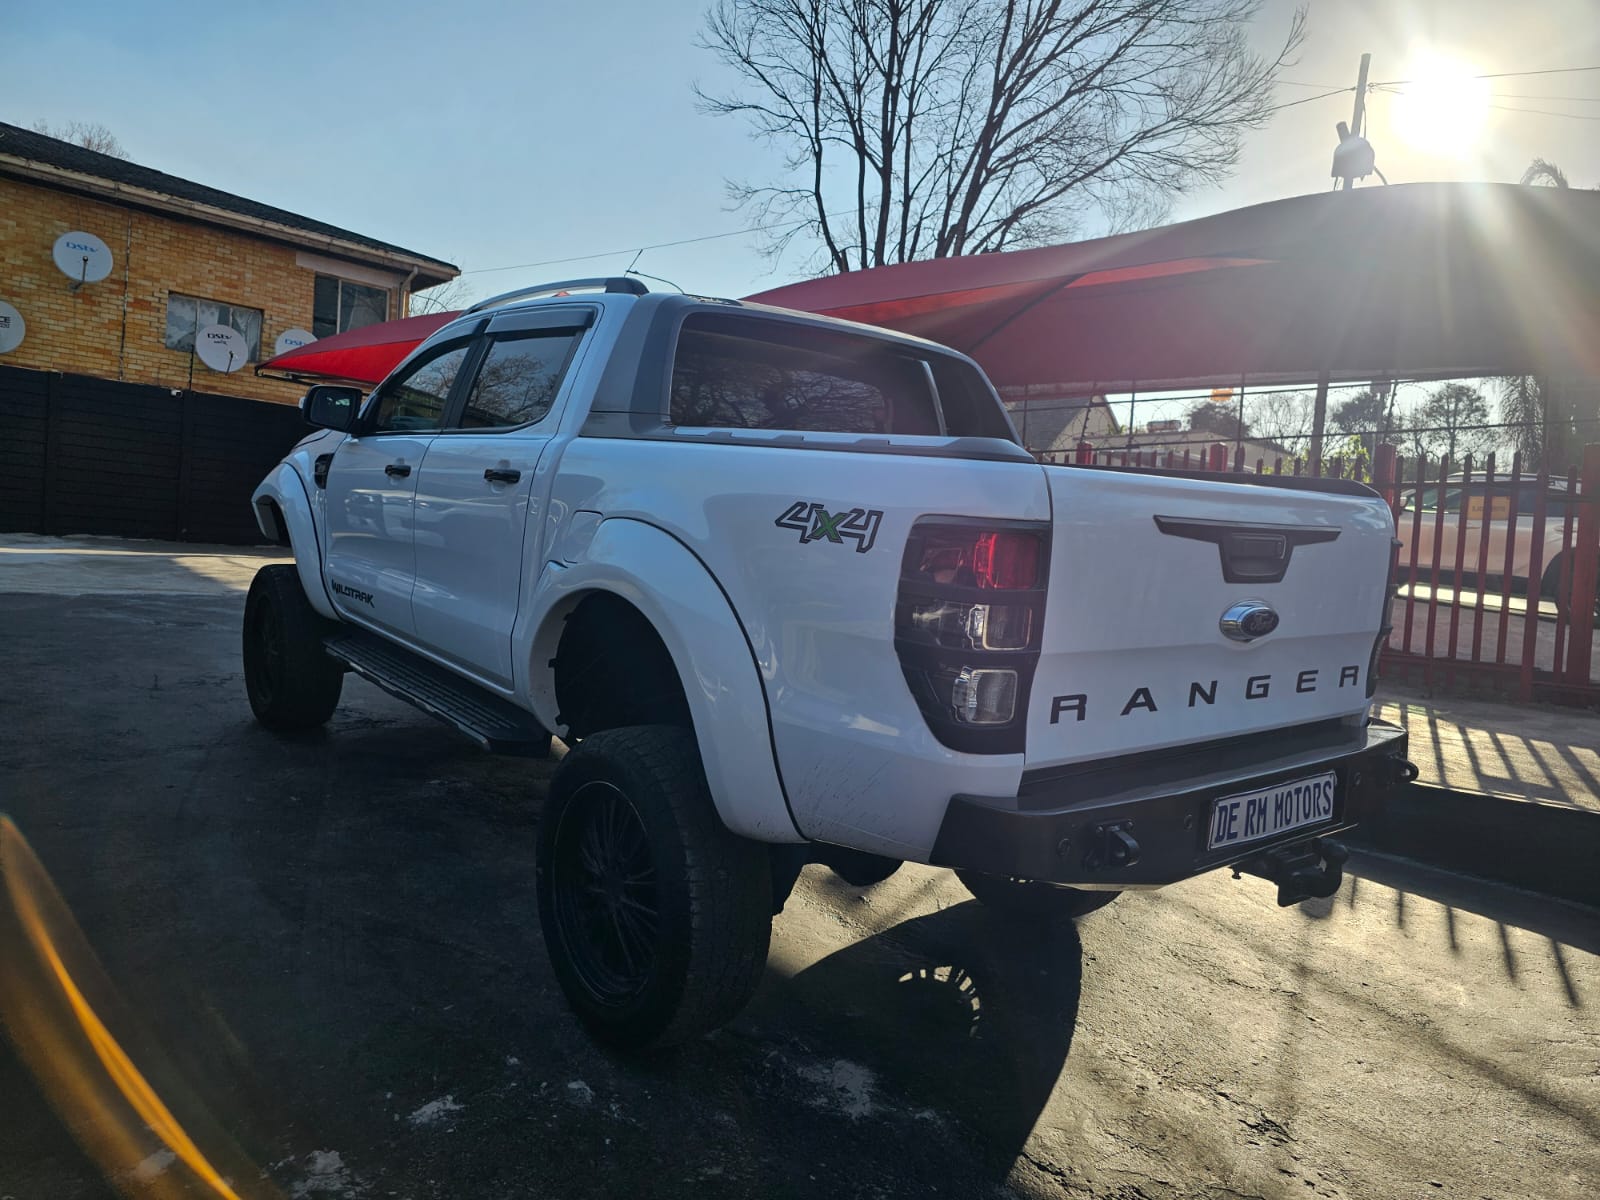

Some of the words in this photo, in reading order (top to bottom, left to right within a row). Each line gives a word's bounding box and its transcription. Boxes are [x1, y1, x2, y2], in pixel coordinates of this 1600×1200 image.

[331, 578, 375, 609] WILDTRAK
[1049, 664, 1359, 725] RANGER
[1214, 801, 1241, 843] DE
[1244, 796, 1268, 837] RM
[1273, 780, 1332, 829] MOTORS
